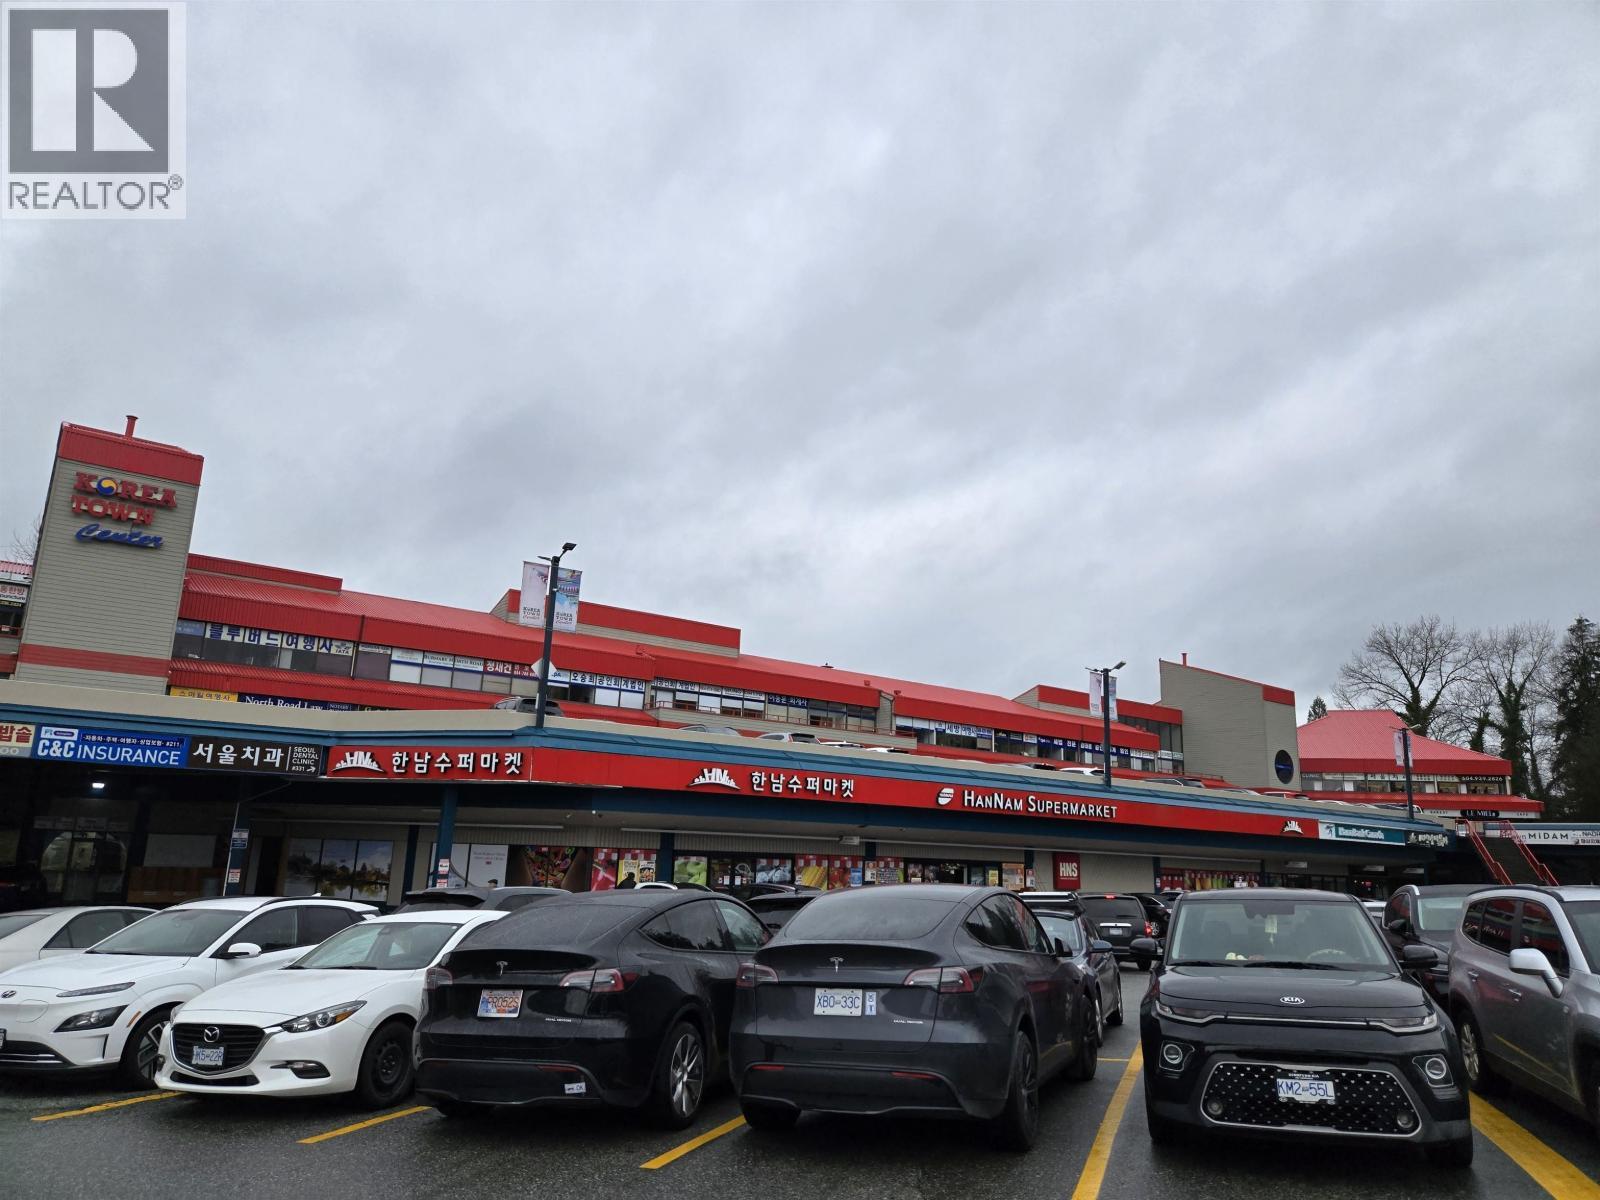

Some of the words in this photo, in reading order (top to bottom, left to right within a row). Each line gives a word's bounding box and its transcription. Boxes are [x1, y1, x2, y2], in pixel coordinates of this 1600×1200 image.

[71, 494, 155, 525] TOWN
[75, 523, 164, 549] Center
[244, 695, 274, 707] North
[277, 699, 302, 709] Road
[37, 738, 76, 758] C&C
[77, 744, 181, 765] INSURANCE
[192, 743, 285, 768] 서울치과
[292, 758, 316, 766] CLINIC
[293, 746, 317, 754] SEOUL
[391, 751, 522, 775] 한남수퍼마켓
[751, 771, 855, 798] 한남수퍼마켓
[1527, 832, 1569, 840] MIDAM
[1059, 862, 1078, 877] HNS
